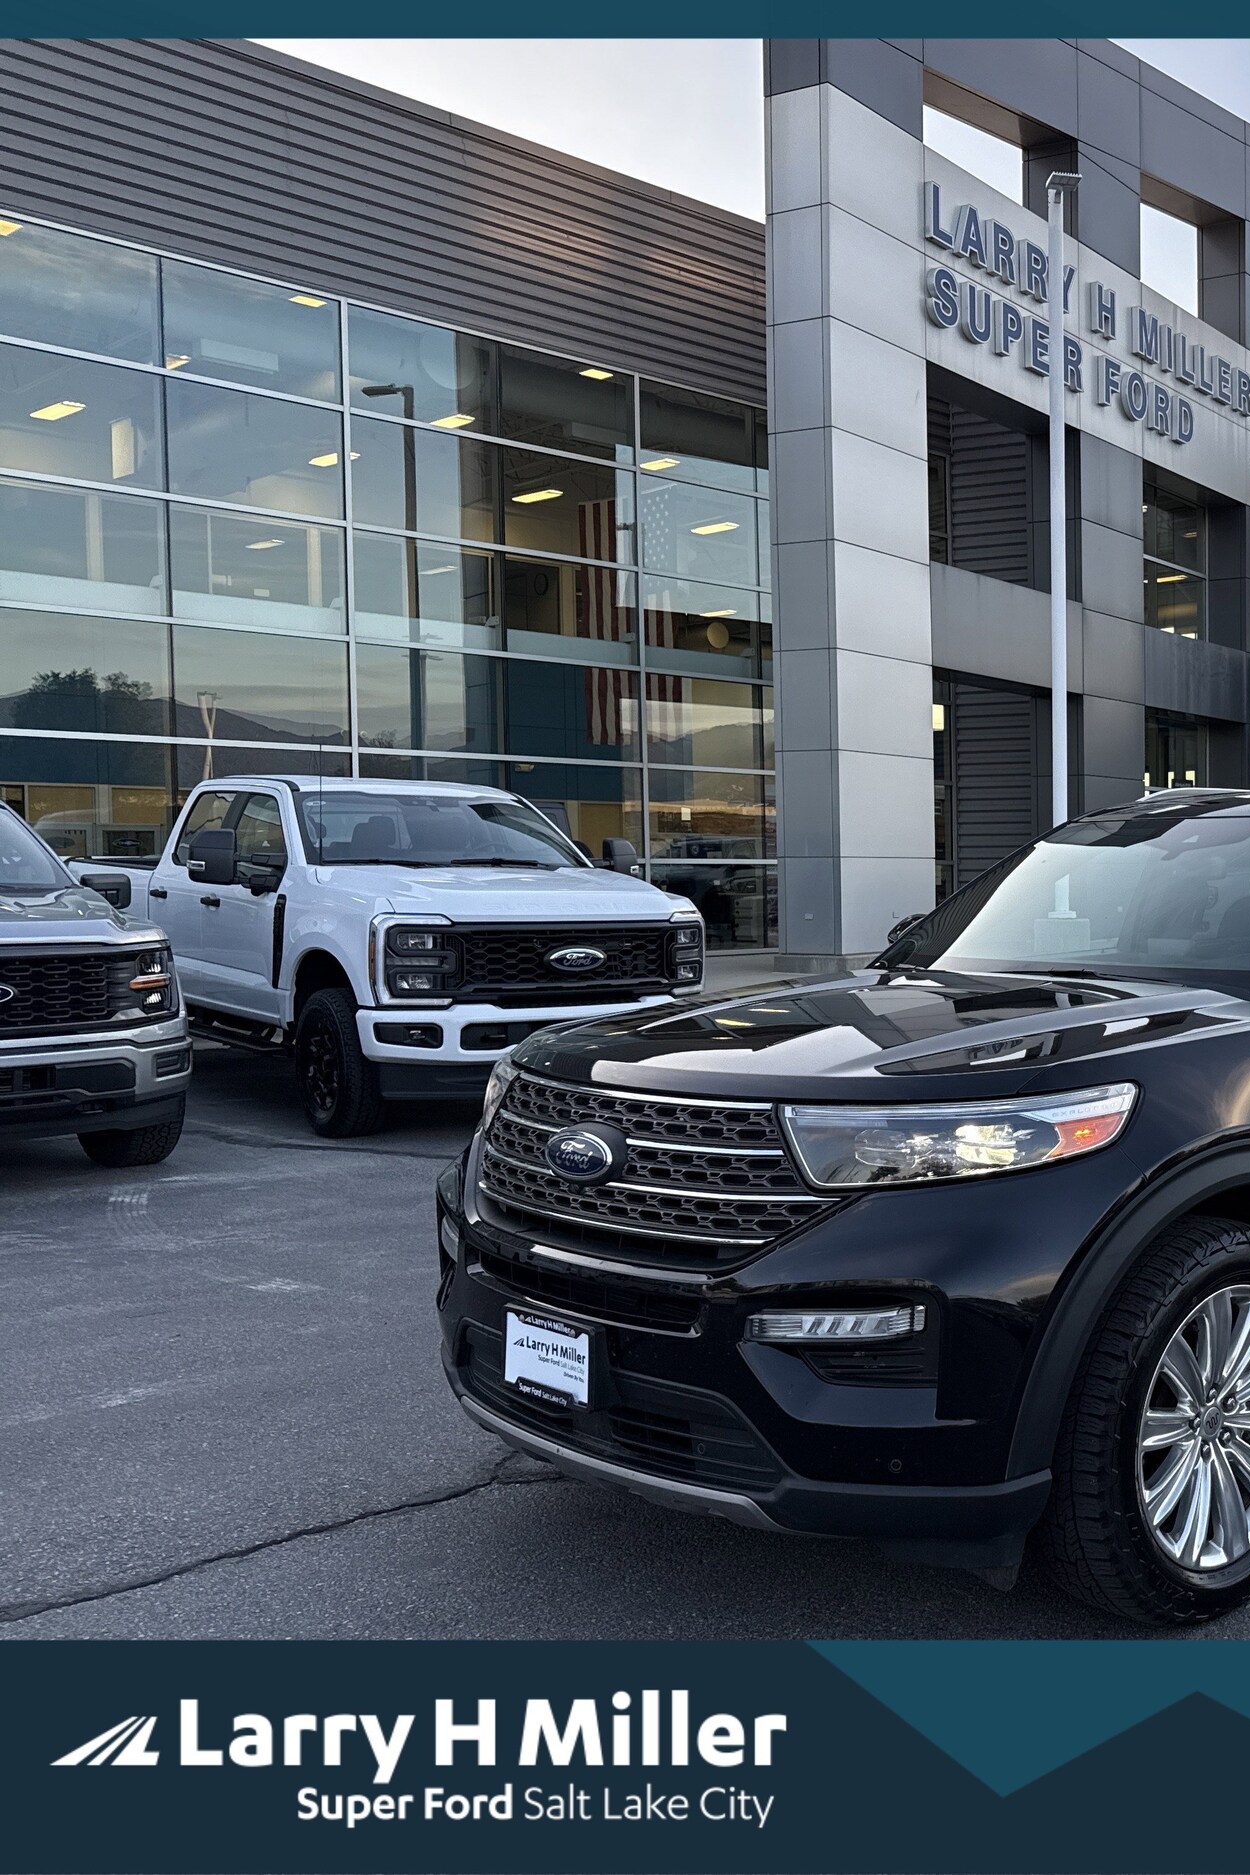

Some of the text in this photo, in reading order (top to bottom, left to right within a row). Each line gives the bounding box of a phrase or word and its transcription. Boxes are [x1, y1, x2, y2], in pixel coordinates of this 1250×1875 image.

[925, 181, 1077, 314] LARRY
[1090, 281, 1117, 340] H
[927, 267, 1194, 445] SUPER FORD
[563, 953, 593, 966] Ford
[555, 1140, 594, 1169] Ford
[531, 1315, 571, 1334] Larry H Miller
[526, 1335, 586, 1365] Larry H Miller
[538, 1354, 550, 1364] Super
[550, 1357, 560, 1367] Ford
[519, 1382, 532, 1394] Super
[532, 1386, 542, 1397] Ford
